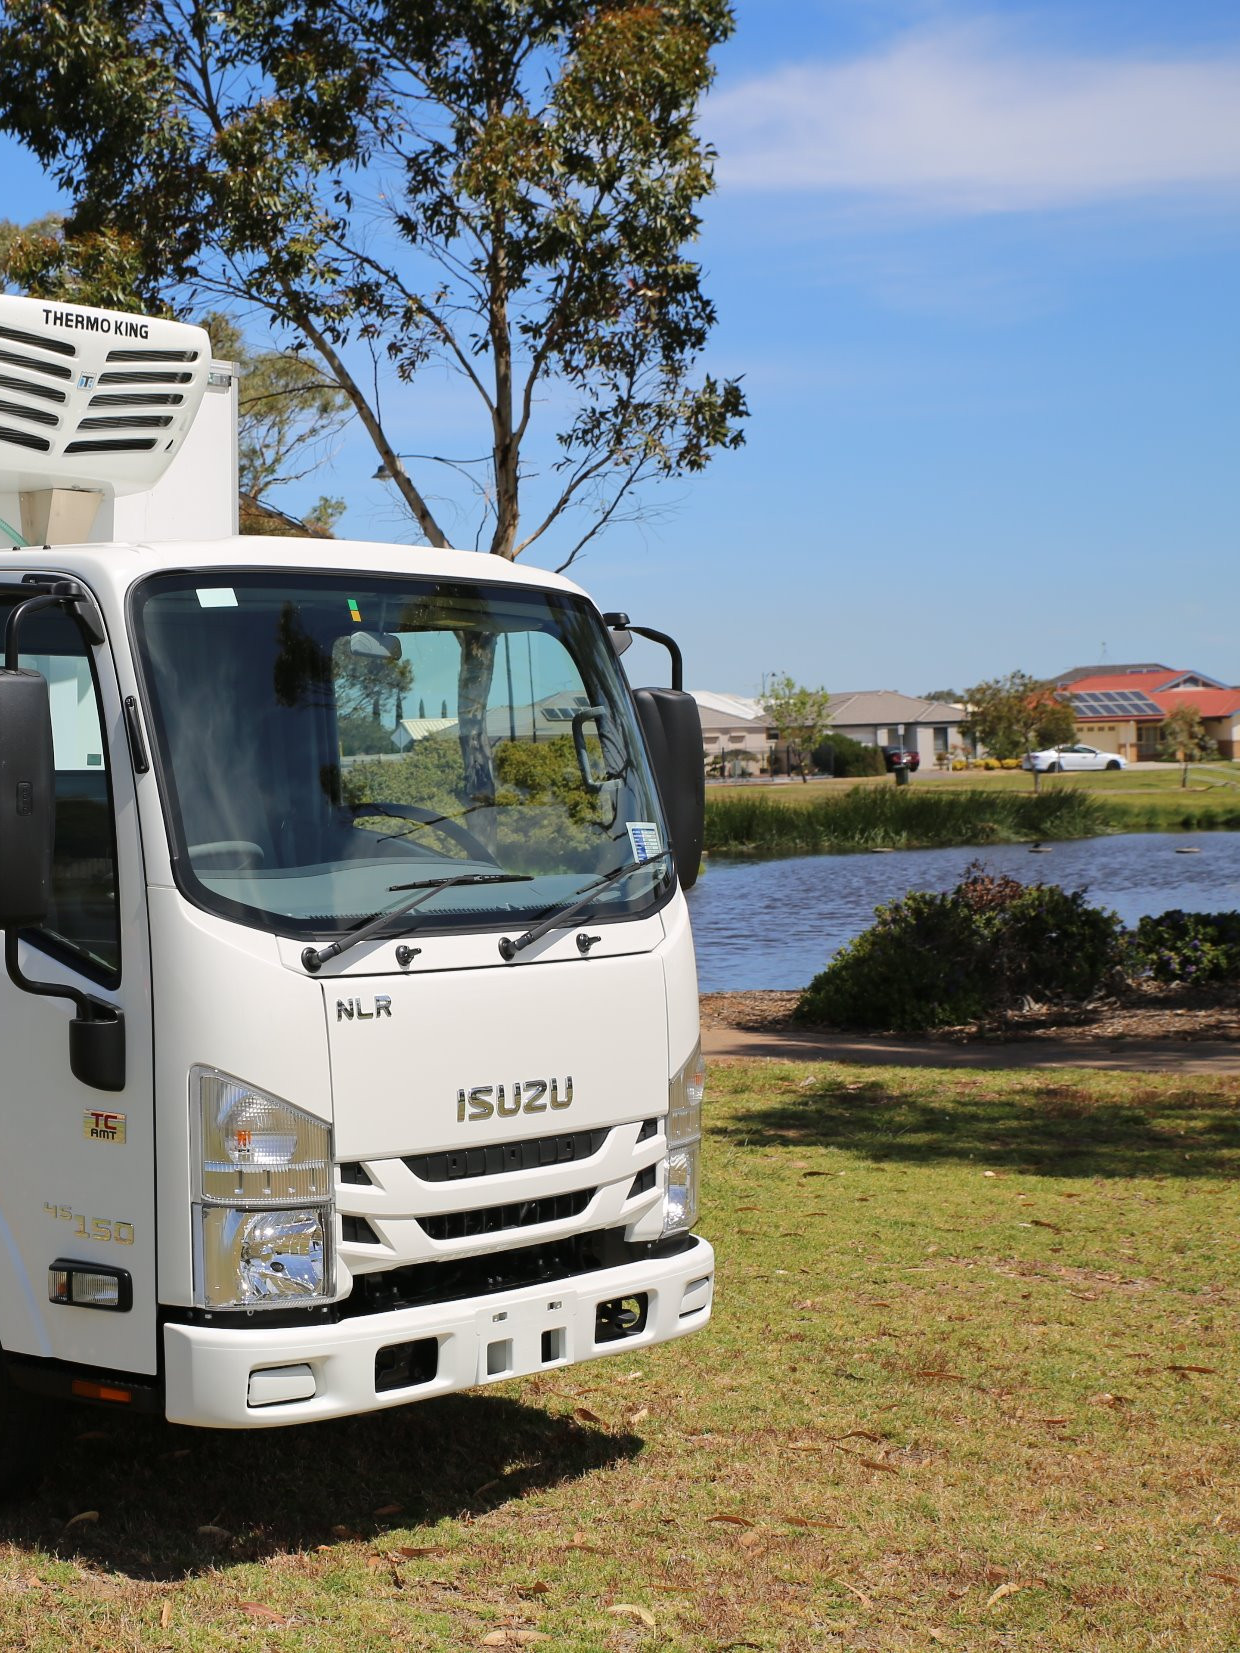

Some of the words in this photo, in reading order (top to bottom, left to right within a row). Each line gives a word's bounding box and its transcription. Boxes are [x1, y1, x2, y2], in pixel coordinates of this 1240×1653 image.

[42, 309, 111, 333] THERMO
[114, 320, 149, 339] KING
[336, 994, 392, 1022] NLR
[456, 1076, 574, 1123] ISUZU
[90, 1128, 117, 1140] AMT
[91, 1112, 118, 1131] TC
[73, 1215, 135, 1245] 150
